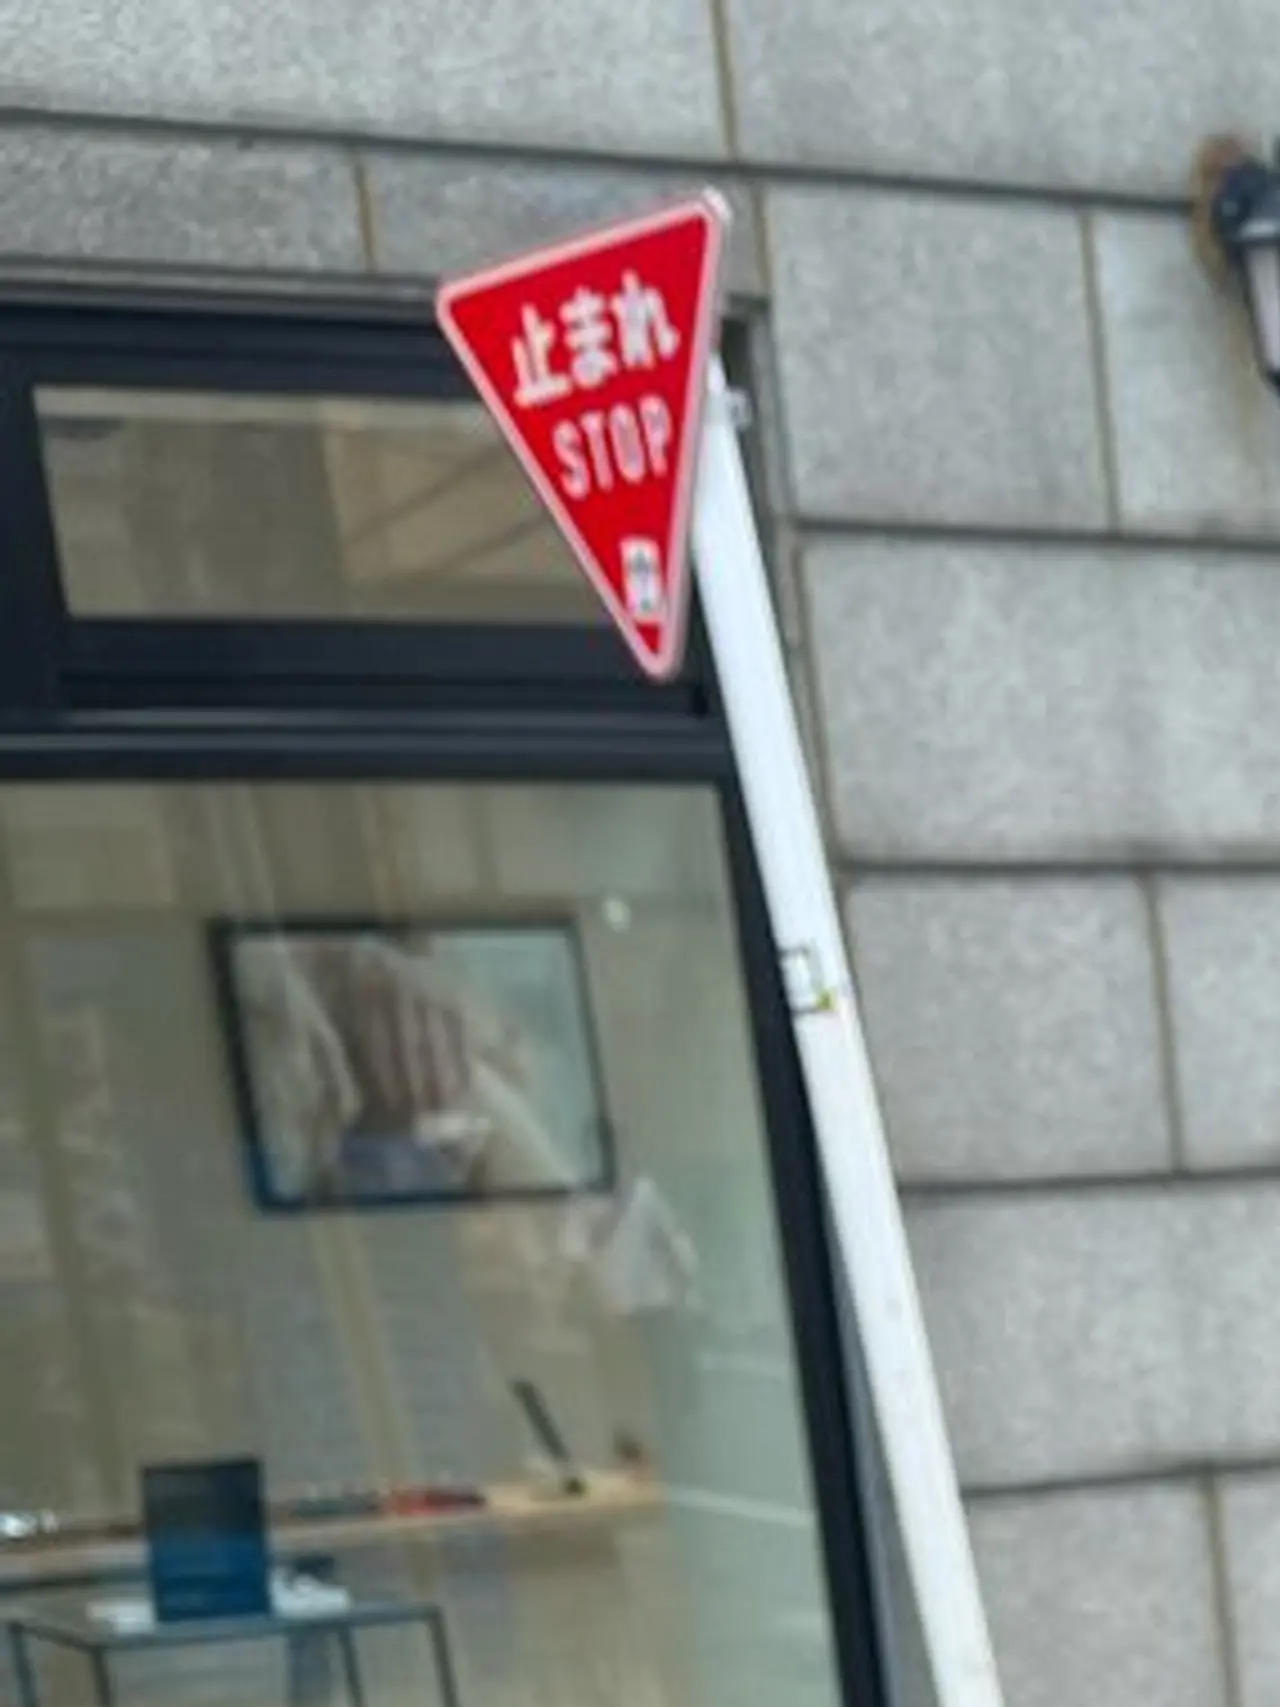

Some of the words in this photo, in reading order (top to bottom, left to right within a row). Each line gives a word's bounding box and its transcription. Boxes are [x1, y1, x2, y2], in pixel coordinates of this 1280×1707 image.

[512, 269, 680, 407] 止まれ
[552, 395, 671, 499] STOP
